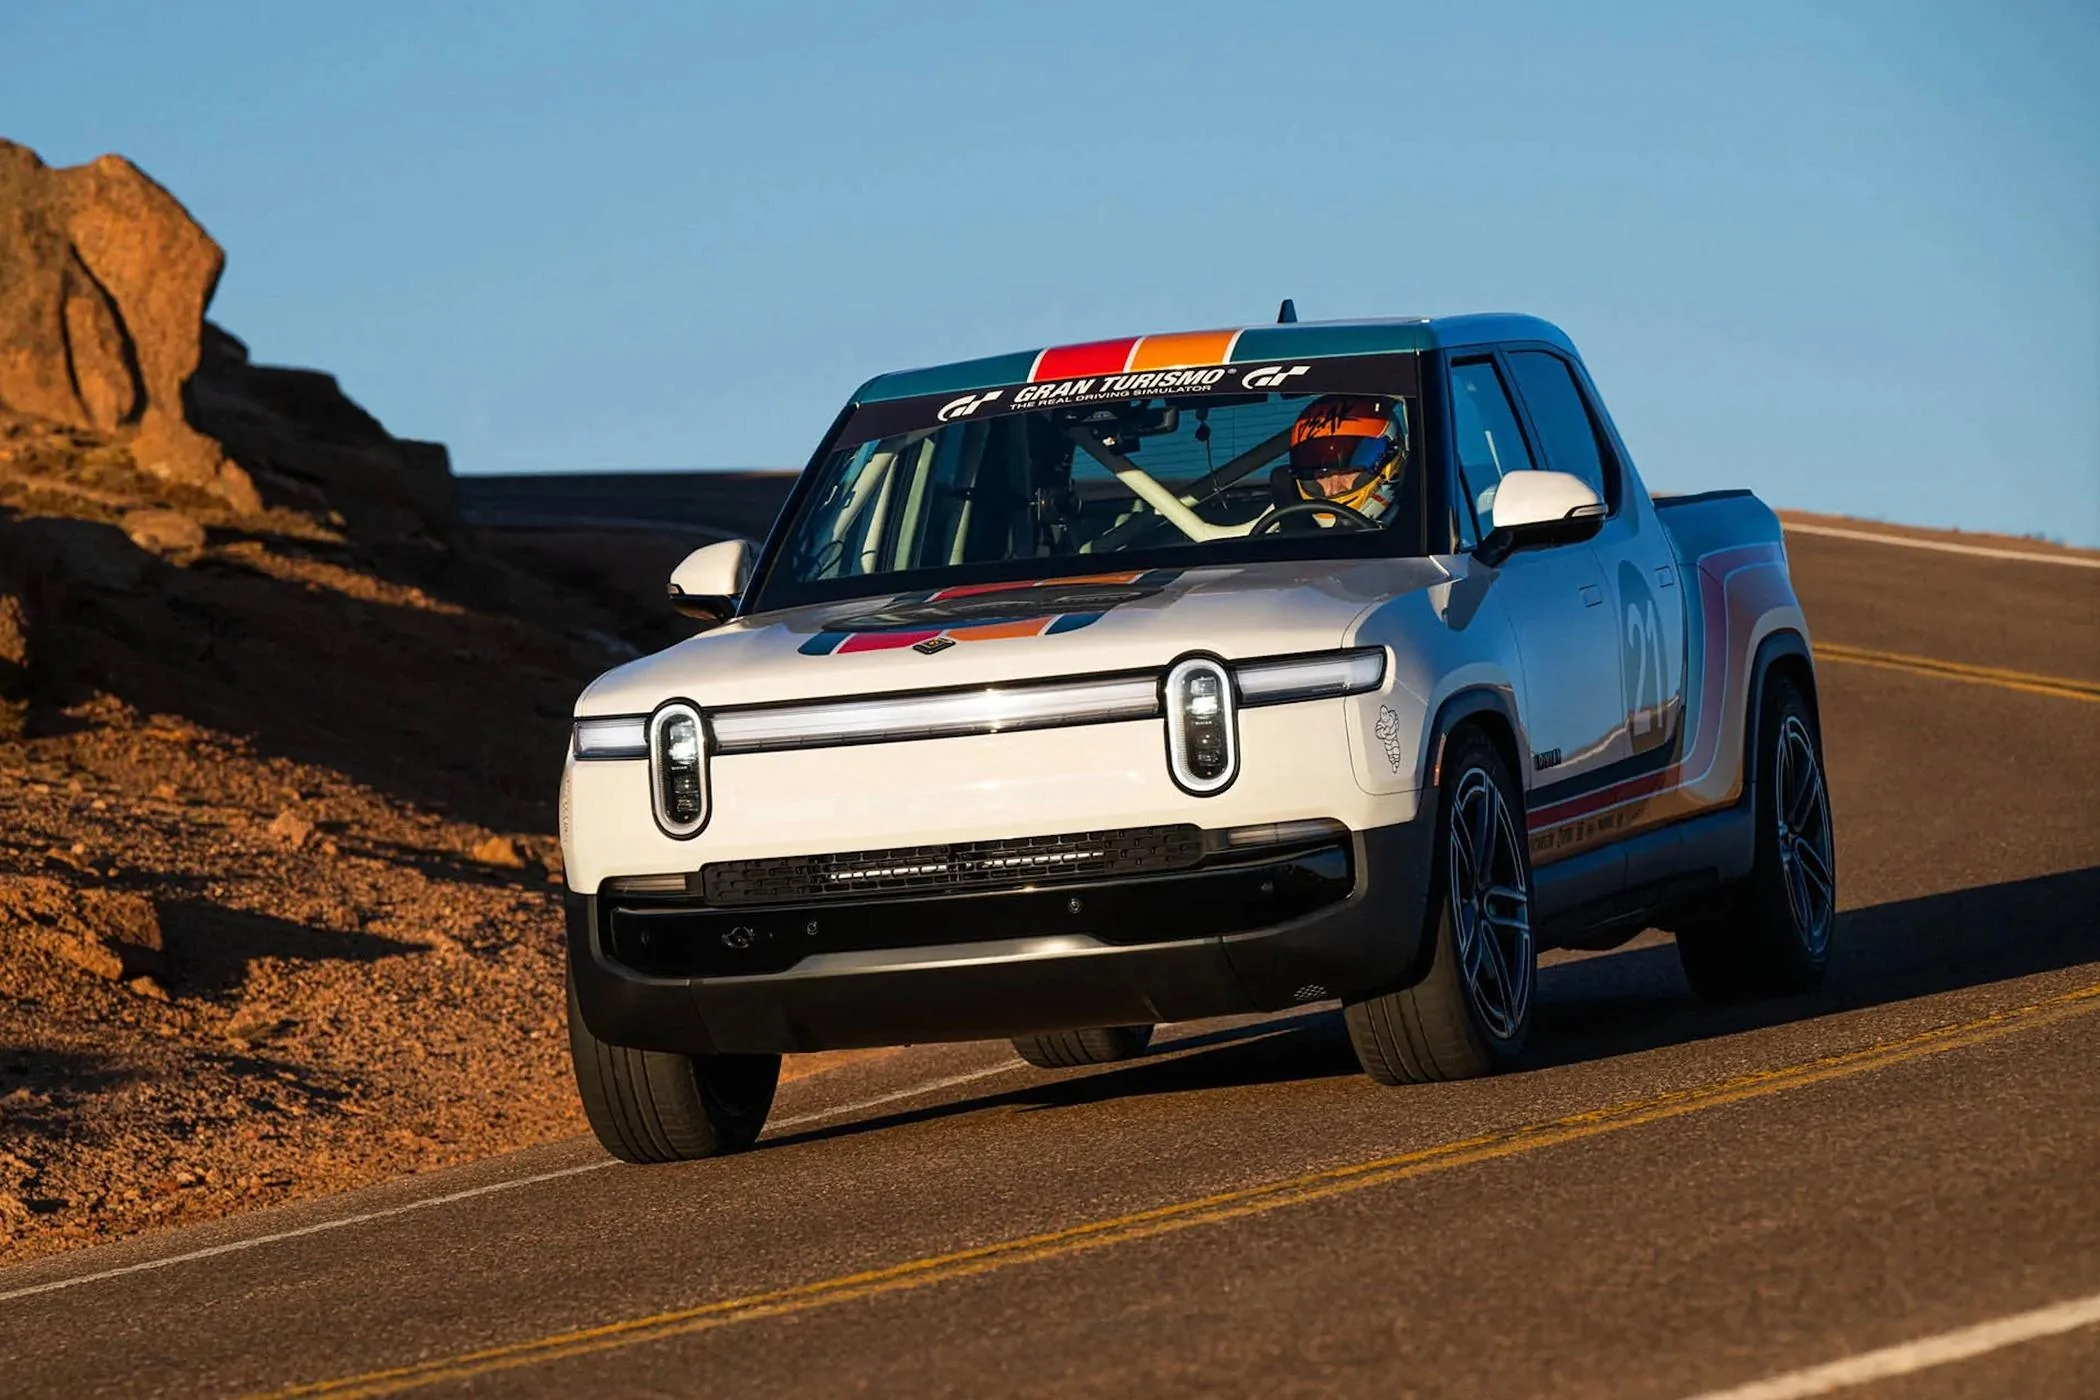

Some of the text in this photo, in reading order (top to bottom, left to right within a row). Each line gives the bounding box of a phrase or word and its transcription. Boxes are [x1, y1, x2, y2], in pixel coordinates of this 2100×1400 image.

[1010, 384, 1212, 410] THE REAL DRIVING SIMULATOR
[1014, 368, 1225, 402] GRAN TURISMO
[1627, 599, 1663, 736] 21
